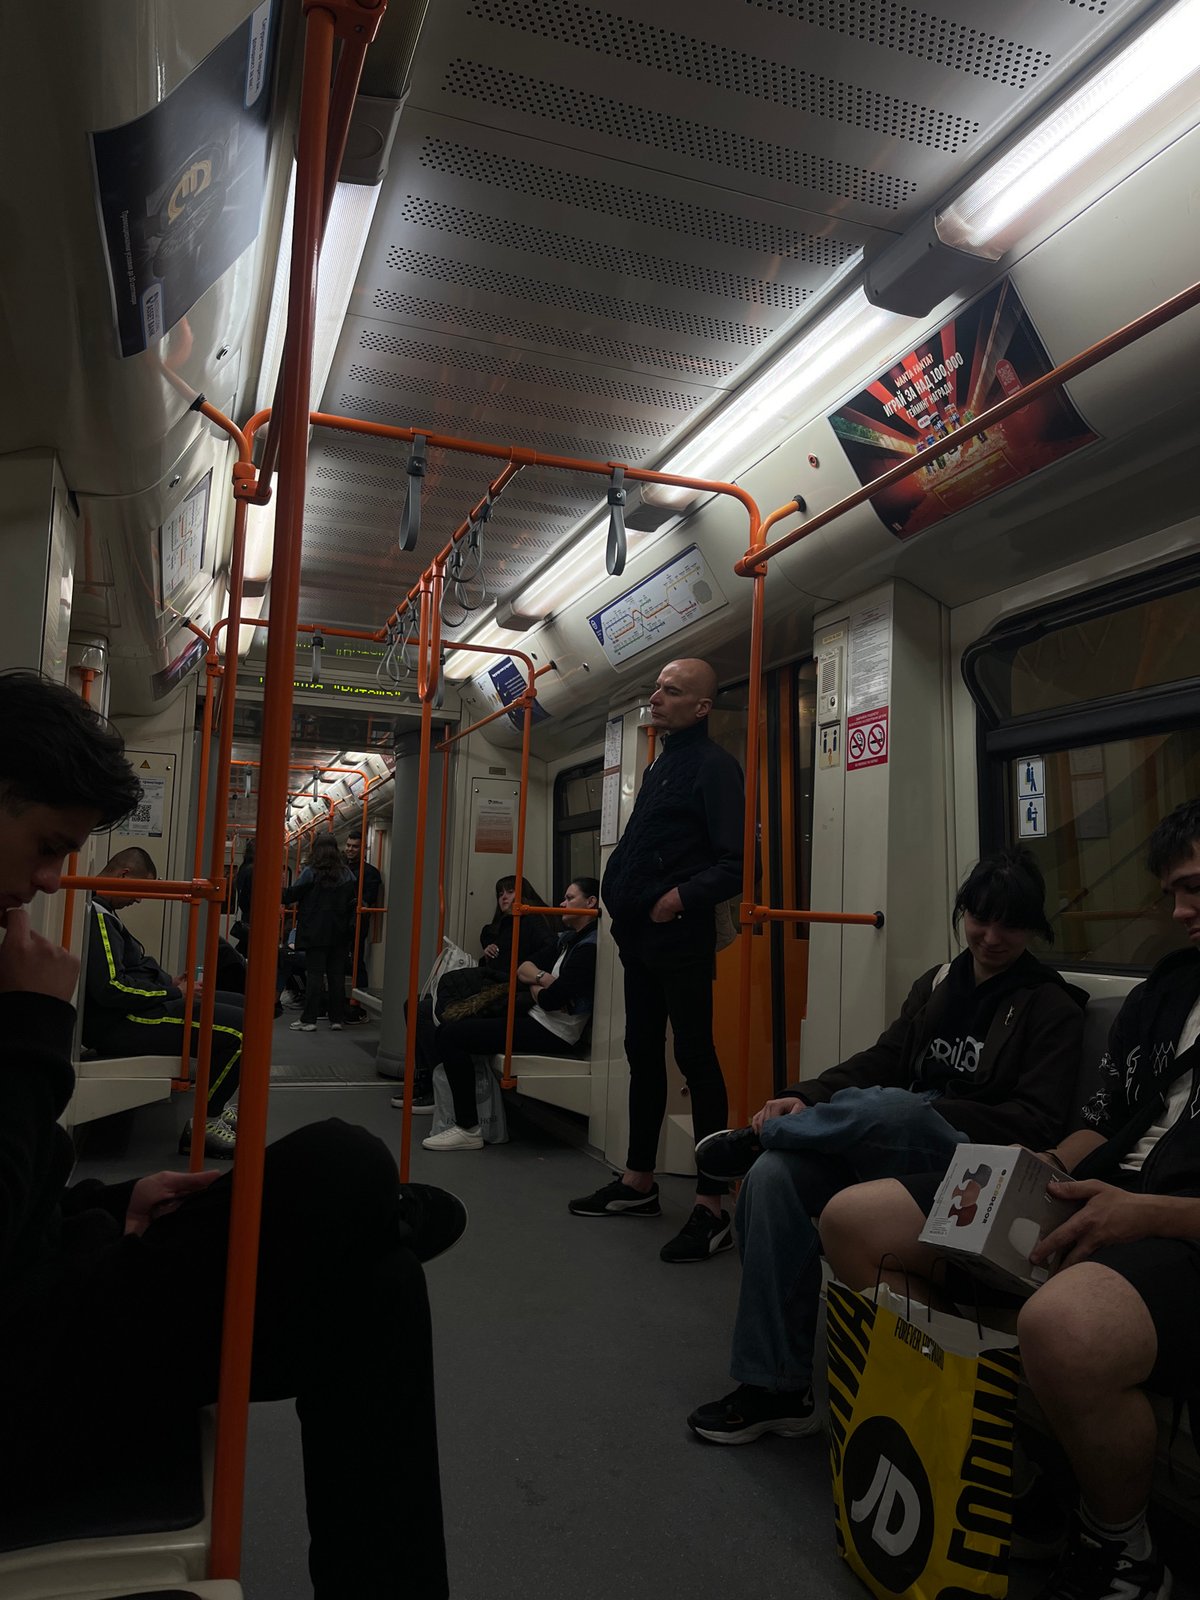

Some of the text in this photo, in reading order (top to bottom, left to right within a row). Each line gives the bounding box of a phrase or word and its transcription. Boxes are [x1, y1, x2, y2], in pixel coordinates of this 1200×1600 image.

[883, 352, 964, 417] ИГРАЙ ЗА НАД 100,000
[894, 369, 915, 388] WANTA
[912, 353, 934, 375] FANTA?
[906, 397, 930, 420] ГЕЙМИНГ
[928, 381, 954, 405] НАГРАДИ
[895, 1317, 921, 1352] FOREVER
[851, 1453, 921, 1557] JD
